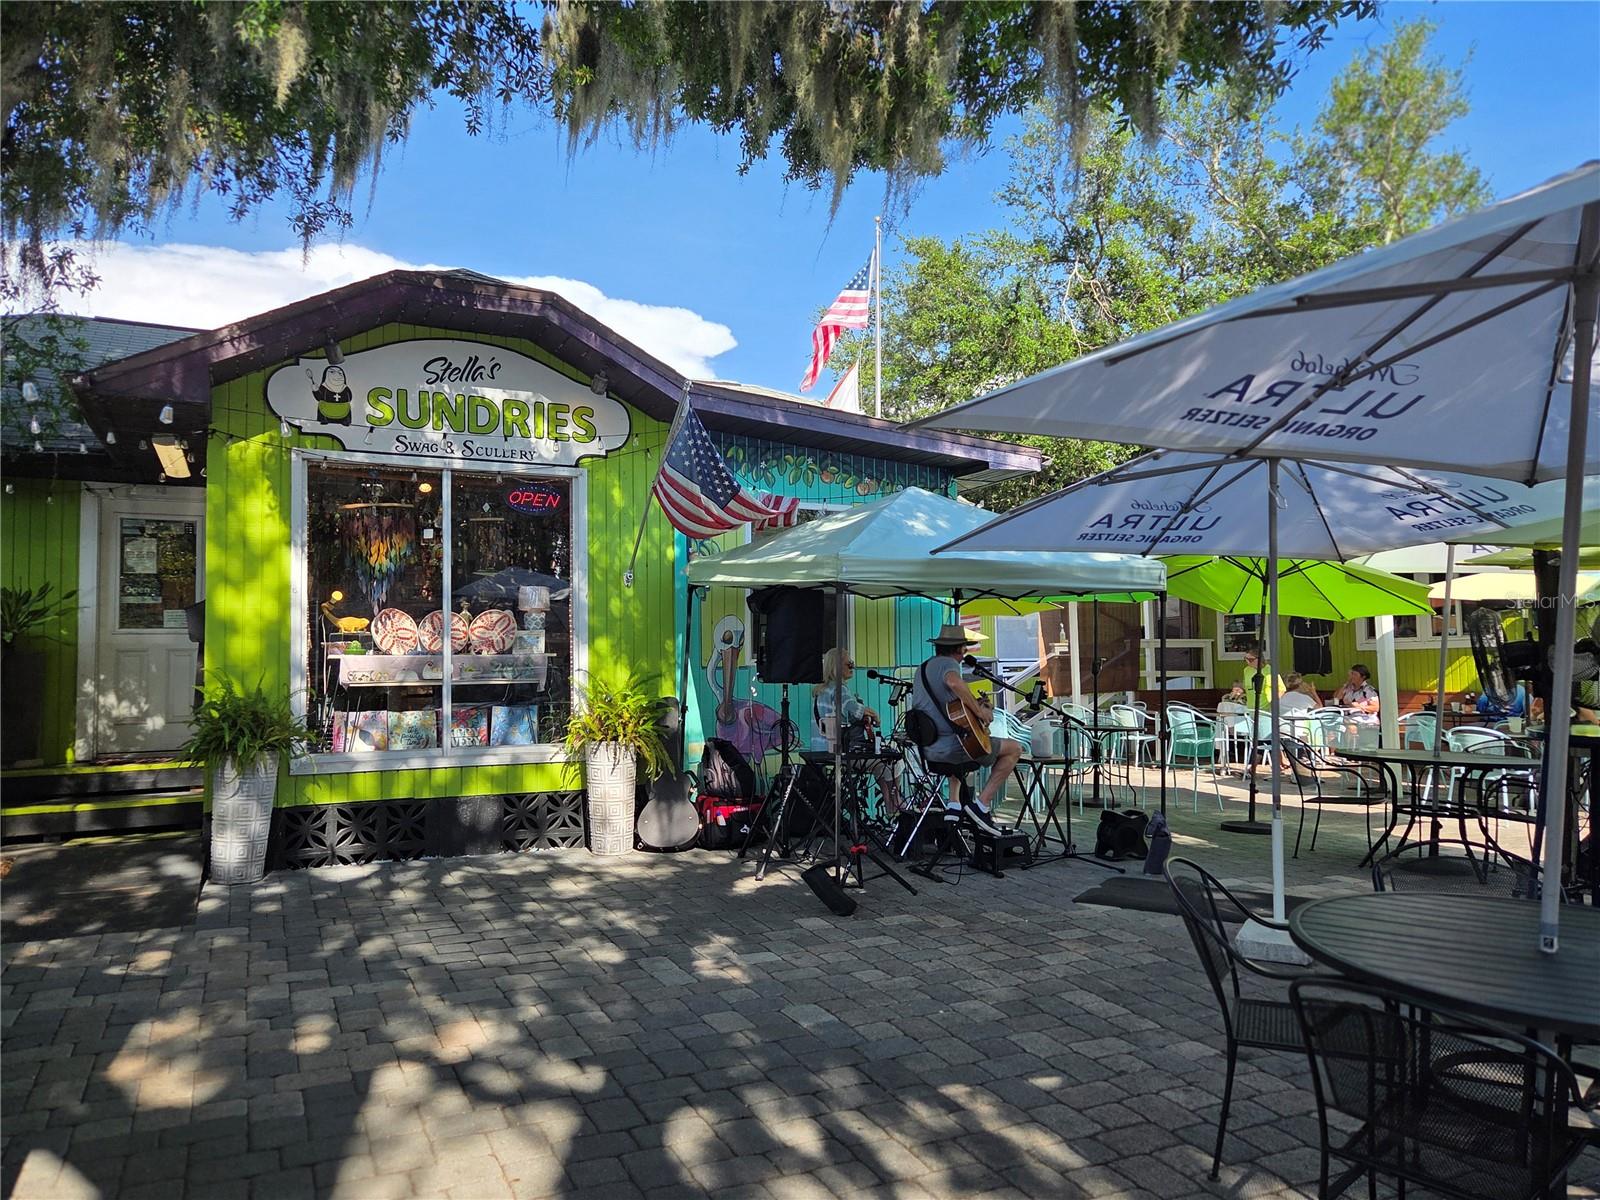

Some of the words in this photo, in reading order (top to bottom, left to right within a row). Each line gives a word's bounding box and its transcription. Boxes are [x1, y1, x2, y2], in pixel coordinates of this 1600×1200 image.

[423, 355, 501, 385] Stella's
[366, 387, 597, 443] SUNDRIES
[509, 491, 560, 507] OPEN
